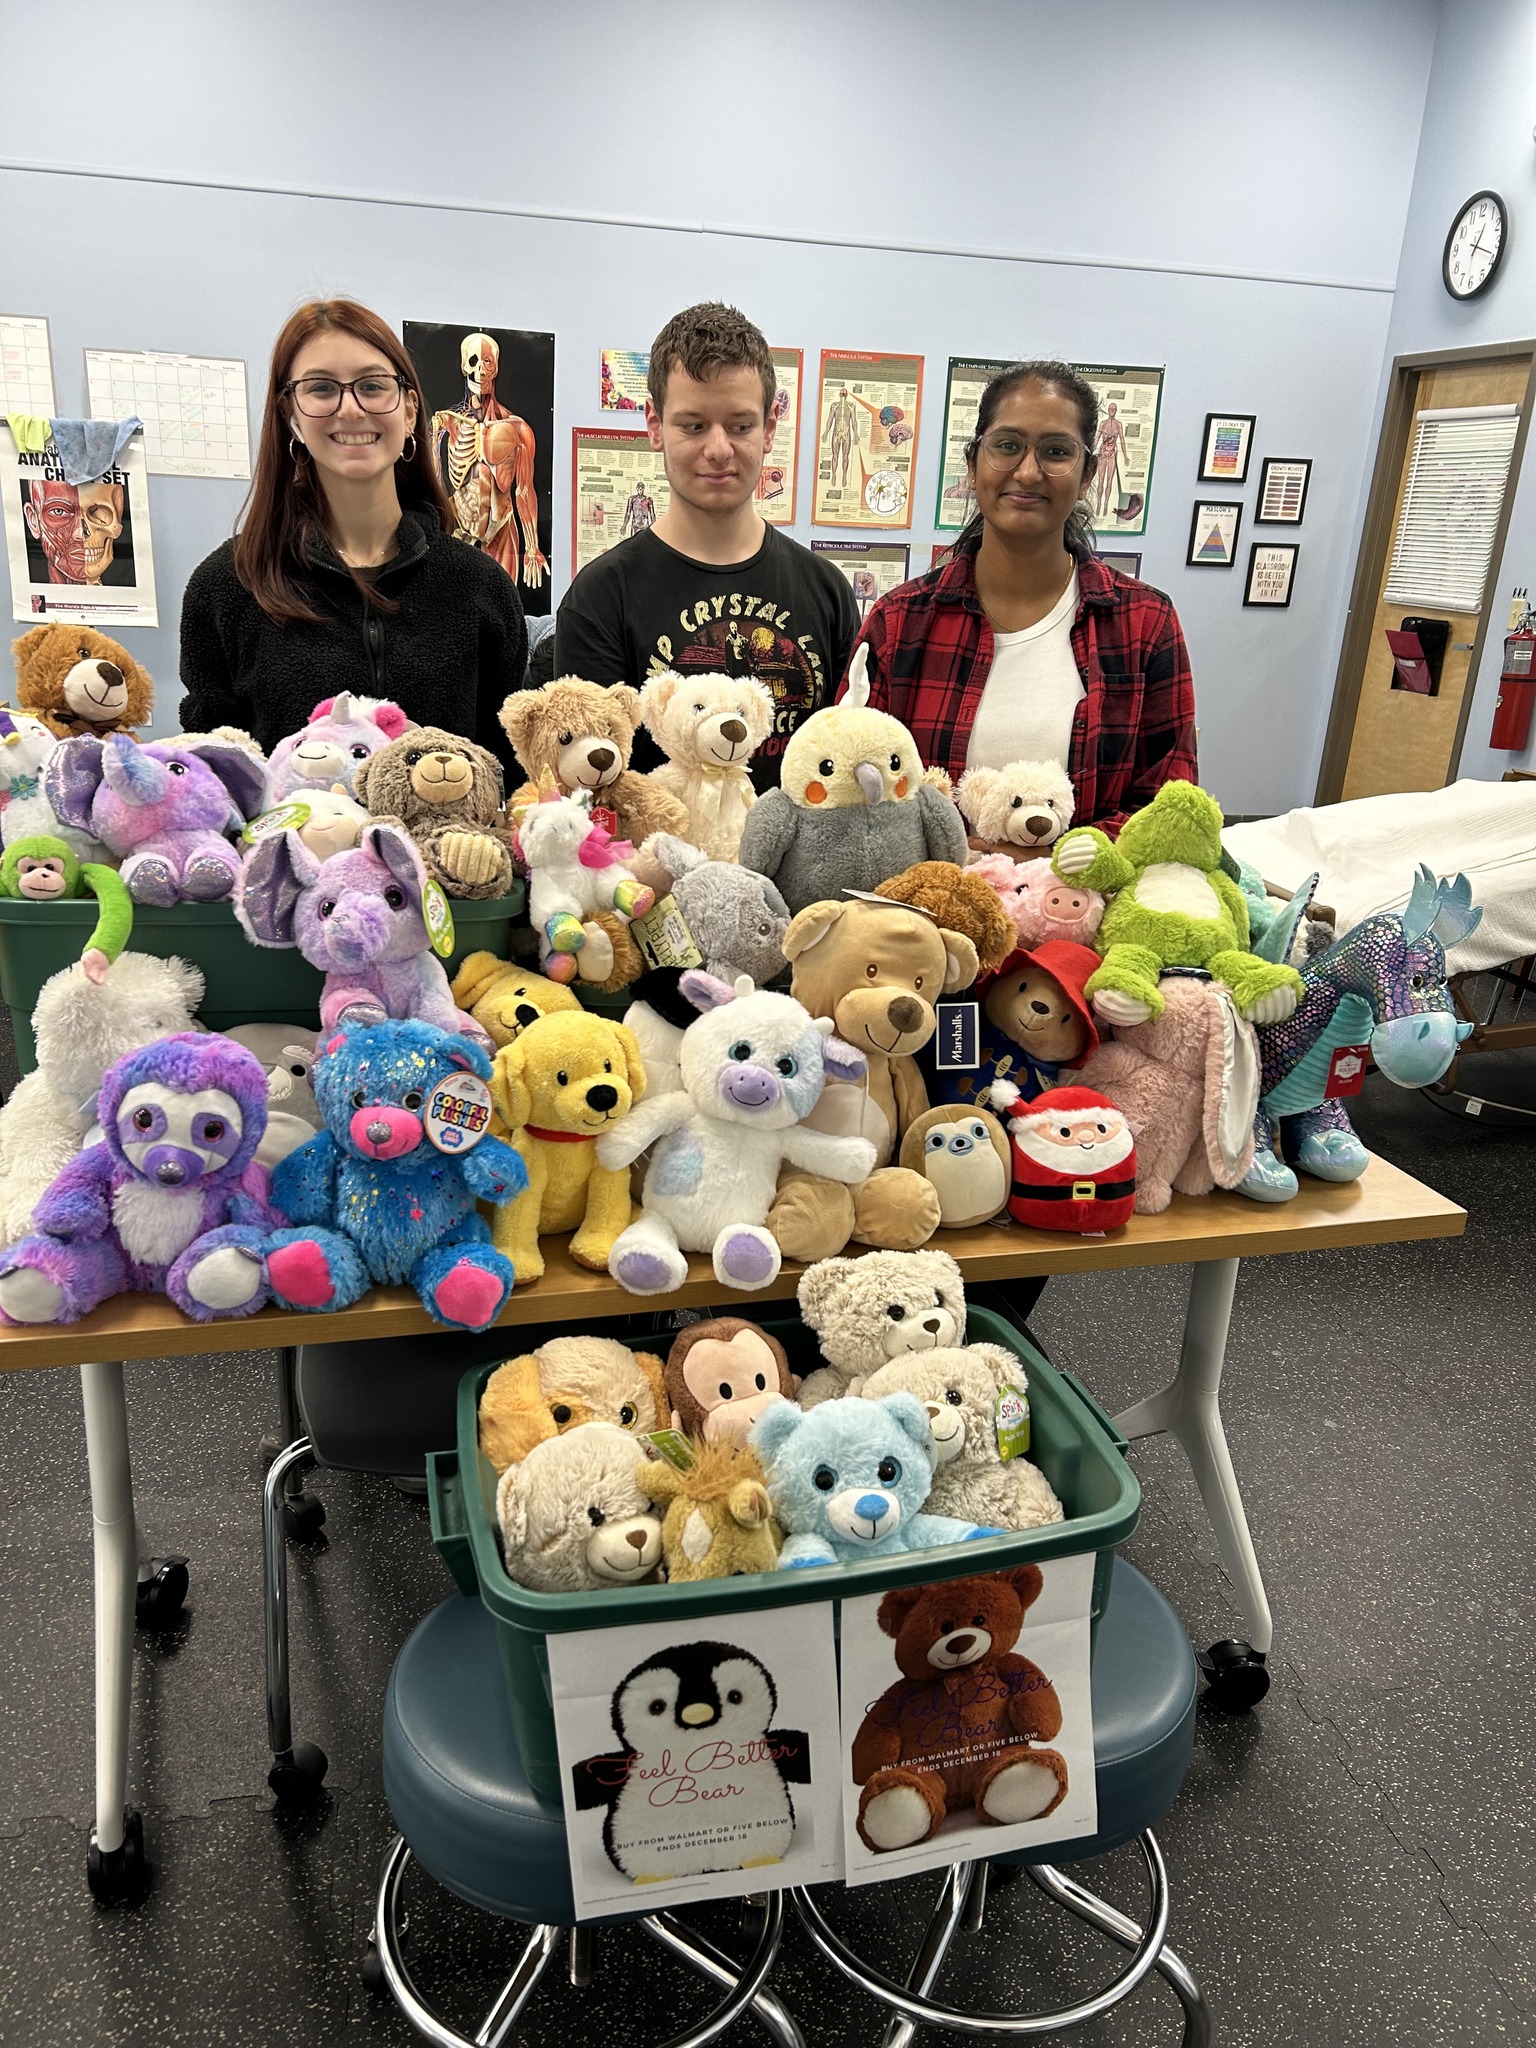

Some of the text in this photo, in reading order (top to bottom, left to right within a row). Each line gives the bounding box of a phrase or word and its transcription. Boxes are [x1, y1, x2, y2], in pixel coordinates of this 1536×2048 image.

[1480, 203, 1487, 217] 12
[1491, 206, 1495, 220] 1
[1470, 211, 1476, 225] 11
[1495, 217, 1501, 231] 2
[1460, 225, 1467, 239] 10
[1454, 244, 1459, 258] 9
[1488, 254, 1494, 265] 4
[1454, 261, 1460, 274] 8
[1460, 272, 1466, 286] 7
[1468, 275, 1474, 289] 6
[1479, 269, 1485, 282] 5
[102, 472, 130, 484] SET
[1256, 562, 1290, 571] CLASSROOM
[680, 593, 791, 633] CRYSTAL
[434, 1092, 488, 1120] COLORFUL
[432, 1104, 485, 1132] PLUSHIES
[951, 1670, 1053, 1708] Better
[918, 1712, 1002, 1748] Bear
[881, 1731, 1039, 1772] BUY FROM WALMART OR FIVE BELOW
[586, 1738, 798, 1786] Feel Better
[917, 1763, 941, 1774] ENDS
[943, 1753, 990, 1768] DECEMBER
[648, 1775, 744, 1807] Bear
[617, 1818, 789, 1850] BUY FROM WALMART OR FIVE BELOW
[656, 1843, 681, 1852] ENDS
[684, 1836, 735, 1848] DECEMBER
